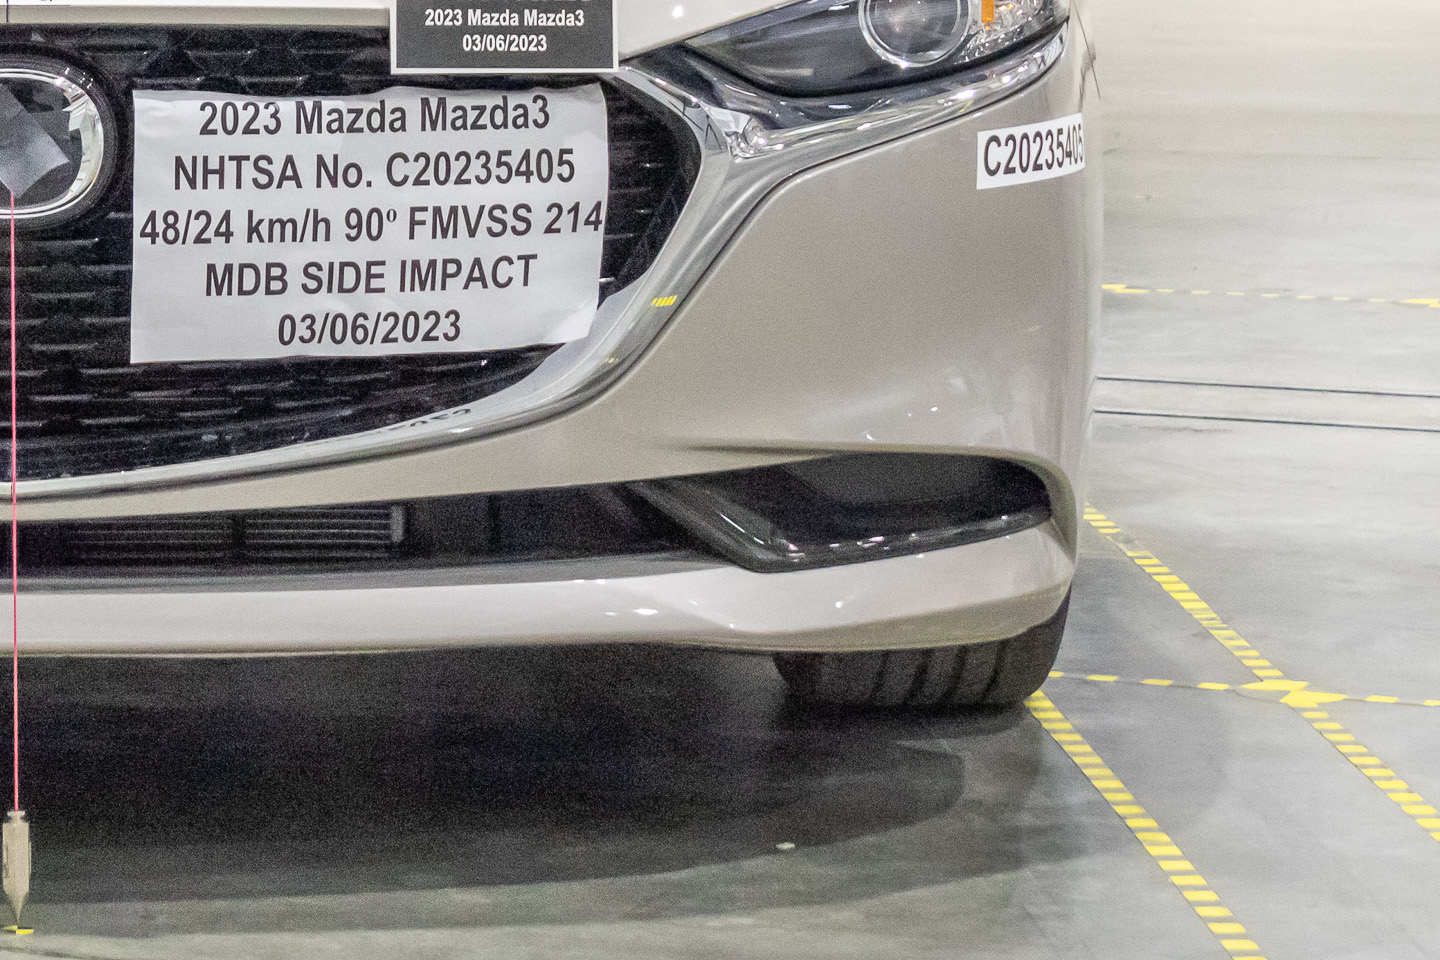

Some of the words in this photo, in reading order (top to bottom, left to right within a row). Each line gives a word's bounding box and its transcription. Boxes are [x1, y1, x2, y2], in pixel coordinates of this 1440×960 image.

[424, 9, 462, 26] 2023
[468, 9, 519, 26] Mazda
[524, 10, 584, 26] Mazda3
[462, 34, 547, 51] 03/06/2023
[199, 101, 283, 135] 2023
[295, 99, 407, 135] Mazda
[420, 94, 550, 132] Mazda3
[174, 154, 303, 190] NHTSA
[316, 153, 373, 188] No.
[386, 148, 575, 187] C20235405
[984, 124, 1083, 177] C20235405
[140, 209, 233, 245] 48/24
[247, 207, 331, 243] km/h
[409, 203, 533, 239] FMVSS
[543, 200, 603, 234] 214
[205, 262, 288, 297] MDB
[301, 260, 386, 295] SIDE
[399, 254, 538, 292] IMPACT
[277, 308, 461, 345] 03/06/2023
